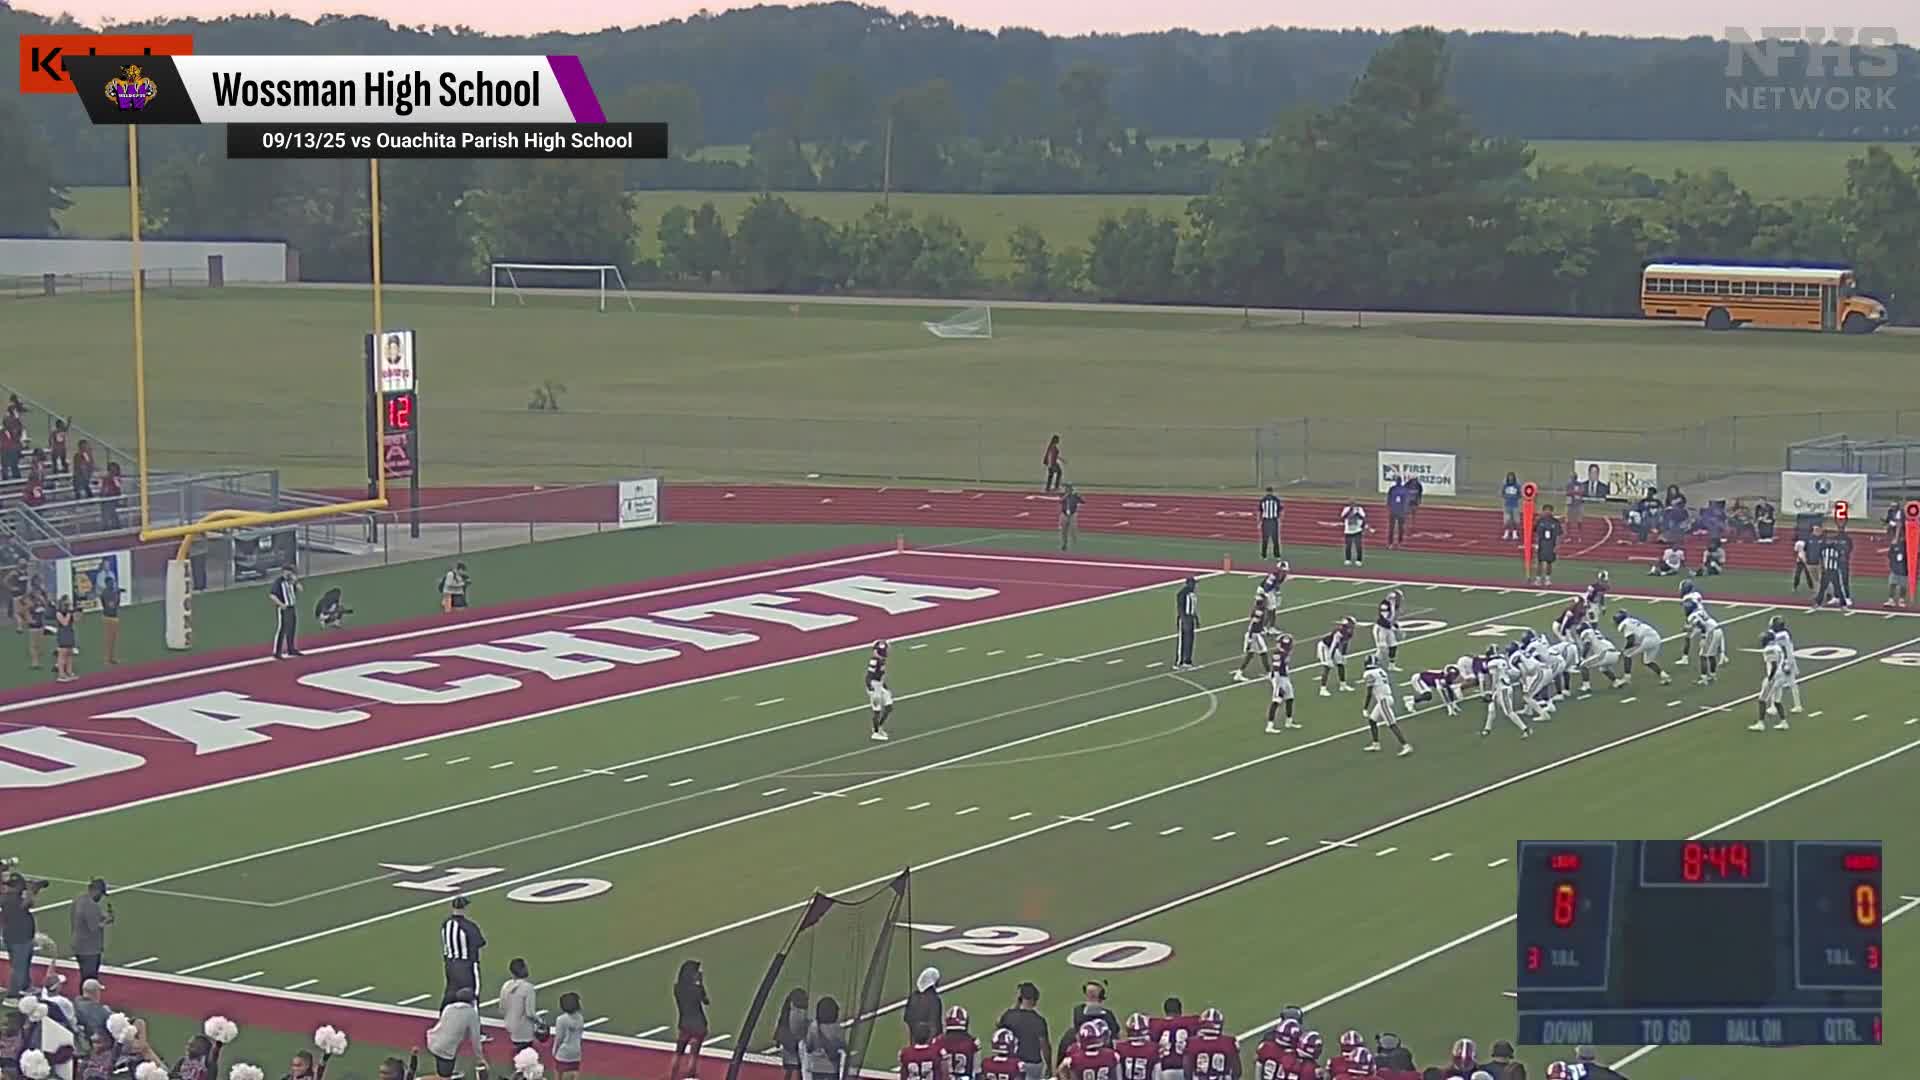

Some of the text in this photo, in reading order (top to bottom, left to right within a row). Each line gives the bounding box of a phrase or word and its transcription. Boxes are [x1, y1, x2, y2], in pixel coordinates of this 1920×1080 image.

[387, 397, 411, 429] 12
[1402, 463, 1432, 474] FIRST
[1836, 501, 1847, 519] 2
